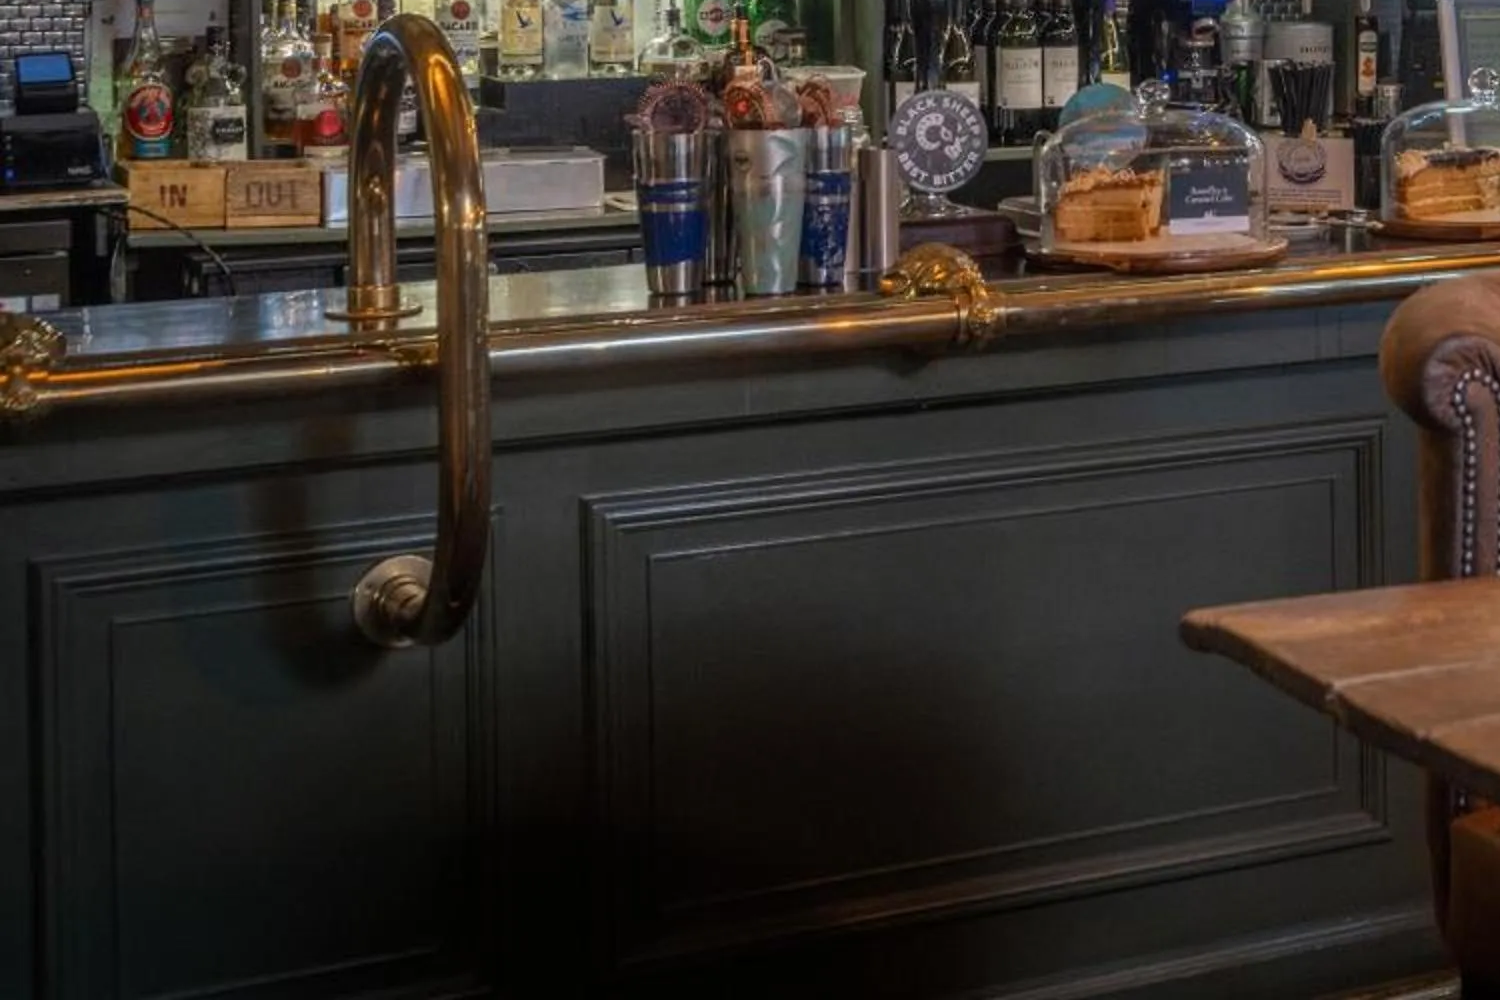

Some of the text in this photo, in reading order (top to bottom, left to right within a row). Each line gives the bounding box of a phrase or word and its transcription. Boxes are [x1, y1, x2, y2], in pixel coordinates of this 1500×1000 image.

[896, 98, 981, 136] BLACK SHEEP
[898, 151, 979, 186] BEST BITTER
[159, 184, 188, 208] IN
[245, 180, 299, 209] OUT
